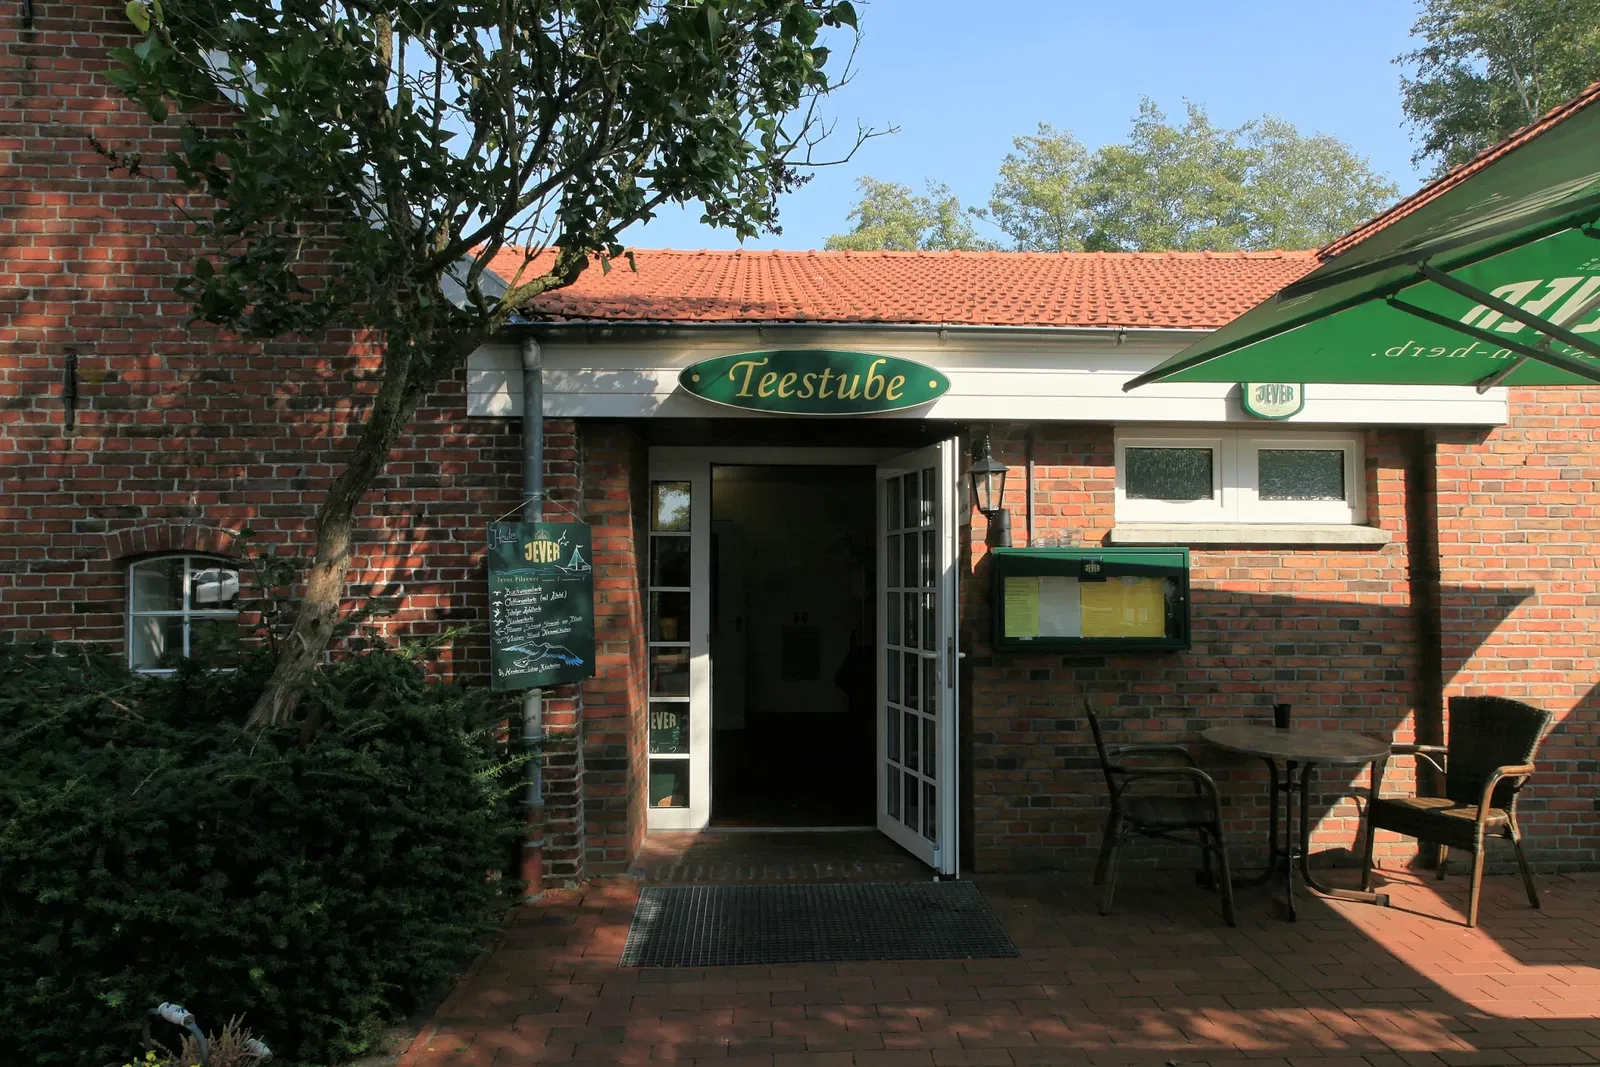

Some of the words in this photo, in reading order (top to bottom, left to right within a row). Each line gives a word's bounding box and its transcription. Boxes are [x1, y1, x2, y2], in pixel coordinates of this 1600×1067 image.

[728, 357, 906, 401] Teestube
[1255, 383, 1294, 405] JEVER
[488, 526, 517, 549] Heute
[524, 540, 561, 563] JEVER
[1084, 563, 1101, 573] JEVER
[650, 711, 677, 730] EVER
